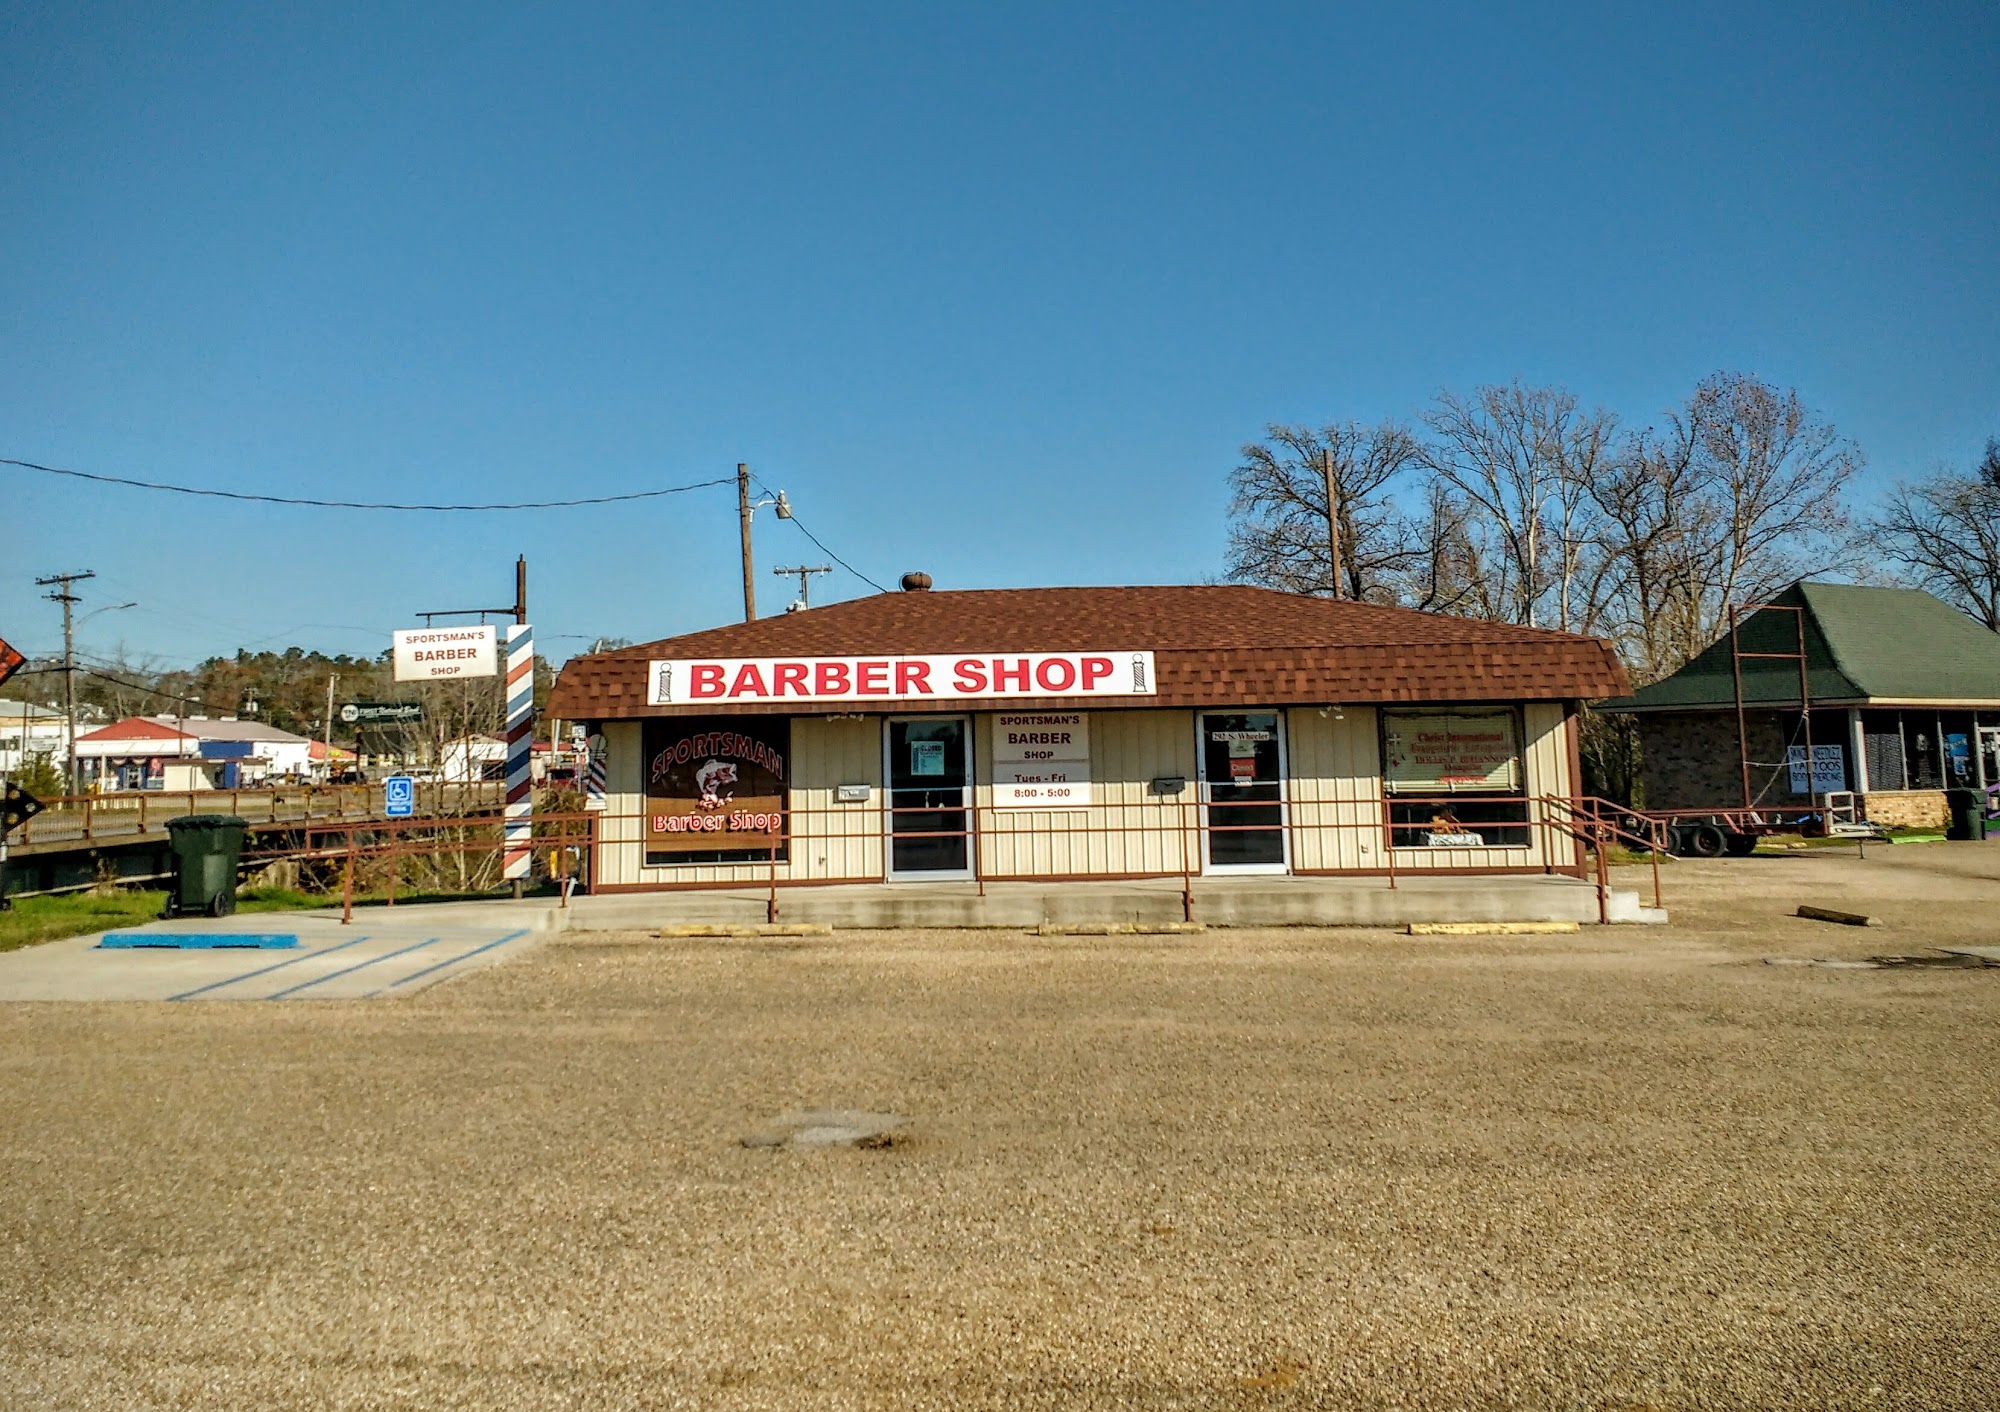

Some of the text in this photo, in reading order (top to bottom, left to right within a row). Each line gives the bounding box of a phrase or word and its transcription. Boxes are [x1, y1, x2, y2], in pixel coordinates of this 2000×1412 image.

[406, 631, 485, 644] SPORTSMAN'S
[414, 648, 477, 661] BARBER
[431, 666, 461, 675] SHOP
[690, 658, 1114, 698] BARBER SHOP
[1000, 715, 1080, 725] SPORTSMAN'S
[1008, 732, 1072, 744] BARBER
[1238, 732, 1269, 740] Wheeler
[651, 732, 783, 784] SPORTSMAN
[1024, 751, 1054, 759] SHOP
[1791, 761, 1842, 771] TATOOS
[1014, 774, 1041, 783] Tues
[1051, 773, 1066, 782] Fri
[1014, 789, 1037, 797] 8:00
[1047, 788, 1071, 797] 5:00
[653, 809, 782, 833] Barber Shop
